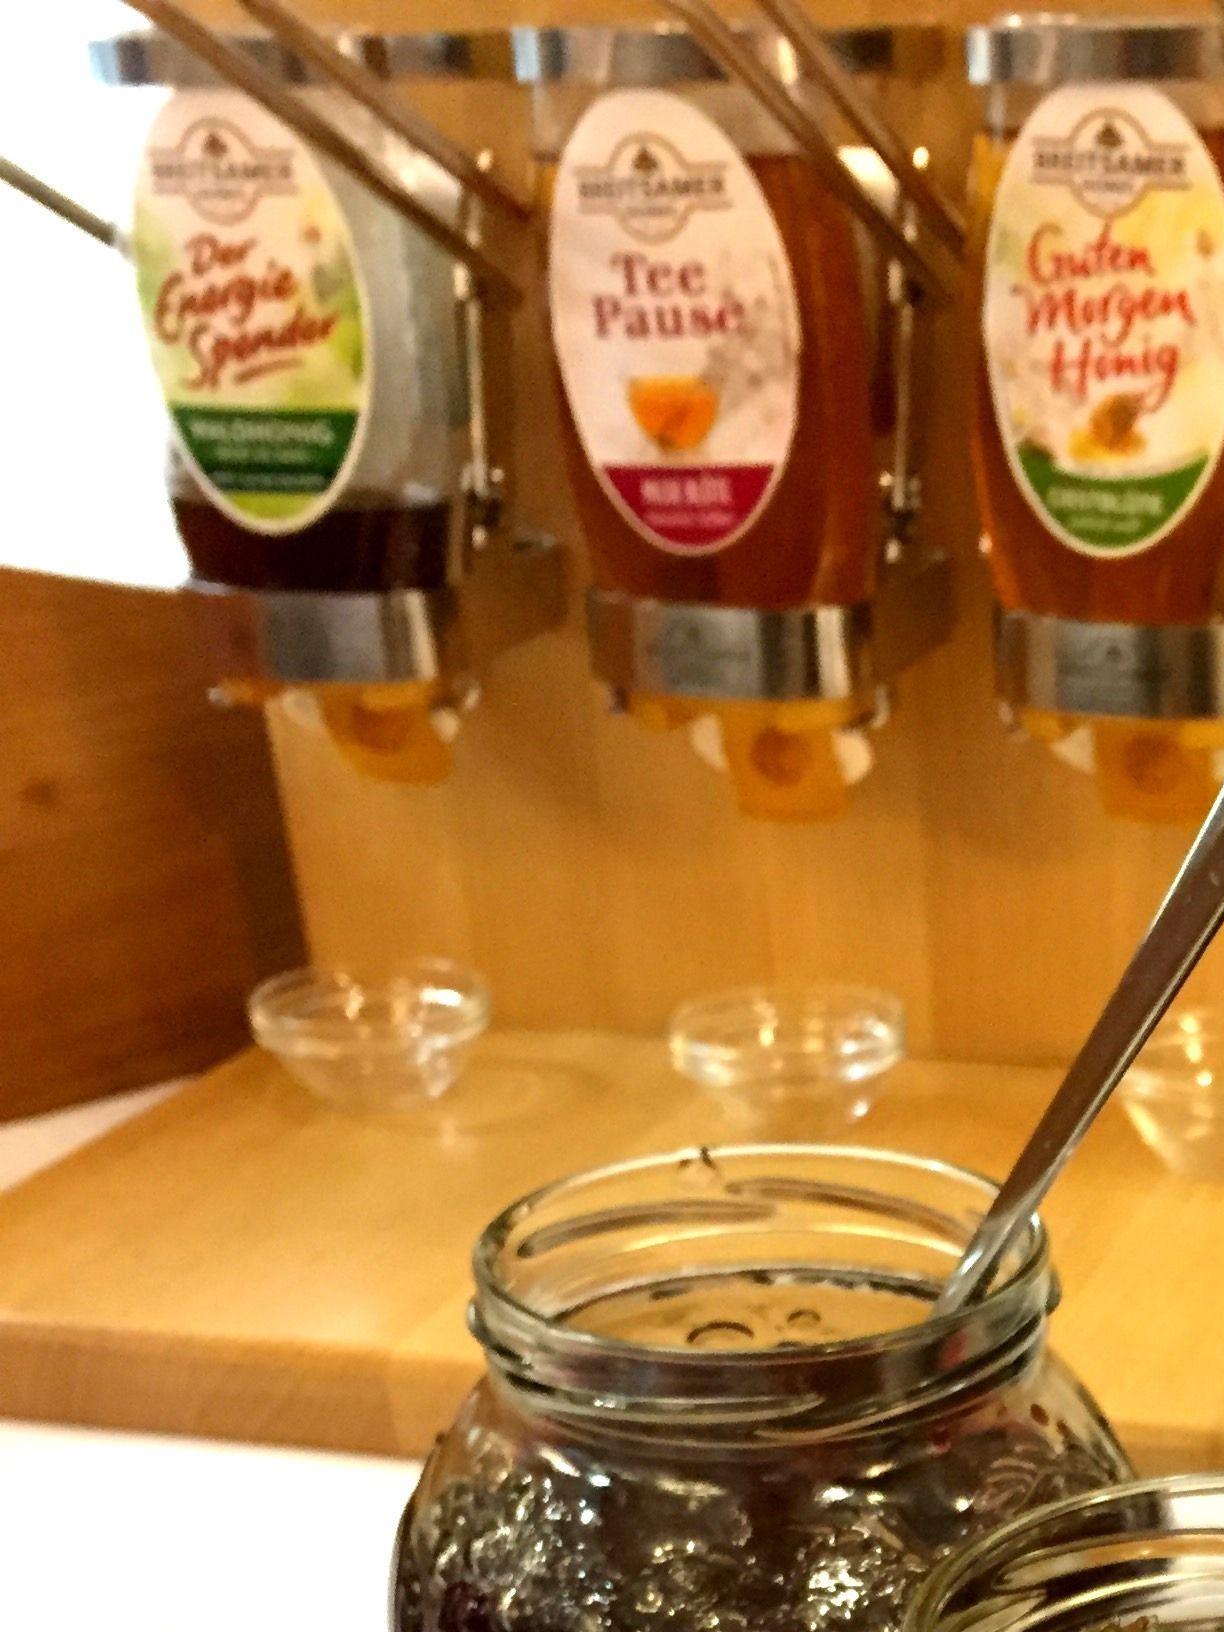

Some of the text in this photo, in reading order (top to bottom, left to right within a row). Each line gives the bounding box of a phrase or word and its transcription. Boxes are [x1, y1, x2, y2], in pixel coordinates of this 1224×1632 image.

[185, 233, 259, 277] Der
[611, 252, 707, 297] Tee
[1026, 221, 1155, 285] Guten
[154, 260, 297, 345] Energie
[592, 296, 746, 341] Pause
[1012, 283, 1197, 346] Morgen
[1046, 334, 1180, 413] Honig
